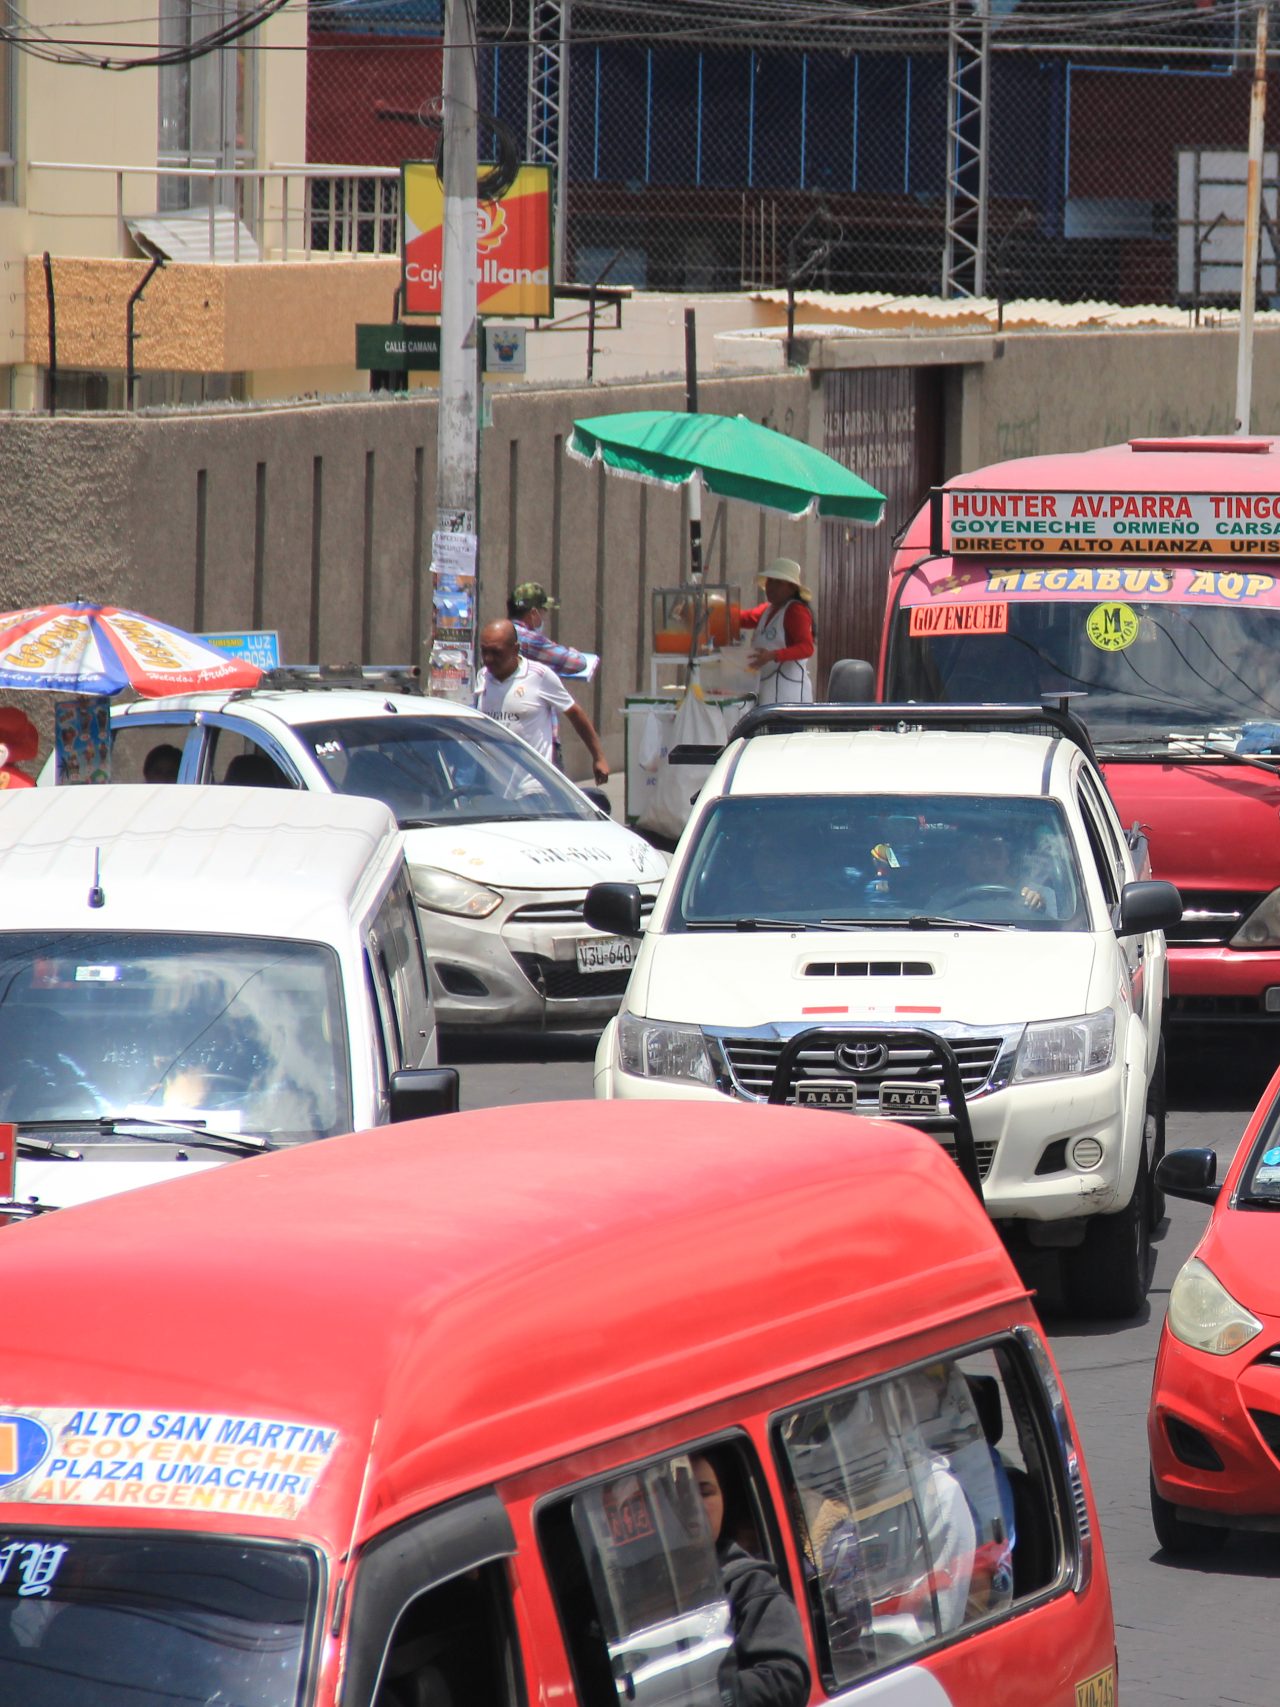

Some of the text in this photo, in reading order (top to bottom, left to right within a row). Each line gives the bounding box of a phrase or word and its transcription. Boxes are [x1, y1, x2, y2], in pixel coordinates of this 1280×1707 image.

[477, 260, 549, 284] llana
[384, 341, 437, 353] CALLE CAMANA
[952, 495, 1057, 518] HUNTER
[1071, 495, 1193, 519] AV.PARRA
[951, 520, 1096, 535] GOYENECHE
[1113, 519, 1200, 535] ORMEÑO
[955, 538, 1280, 553] DIRECTO ALTO ALIANZA UPIS
[985, 567, 1276, 600] MEGABUS AQP
[913, 604, 1005, 631] GOYENECHE
[1103, 607, 1122, 635] M
[247, 636, 272, 650] LUZ
[197, 665, 237, 683] Aruba
[580, 944, 632, 967] V3U-640
[62, 1411, 336, 1454] ALTO SAN MARTIN
[61, 1438, 324, 1475] GOYENECHE
[48, 1459, 313, 1496] PLAZA UMACHIRI
[31, 1480, 299, 1514] AV. ARGENTINA
